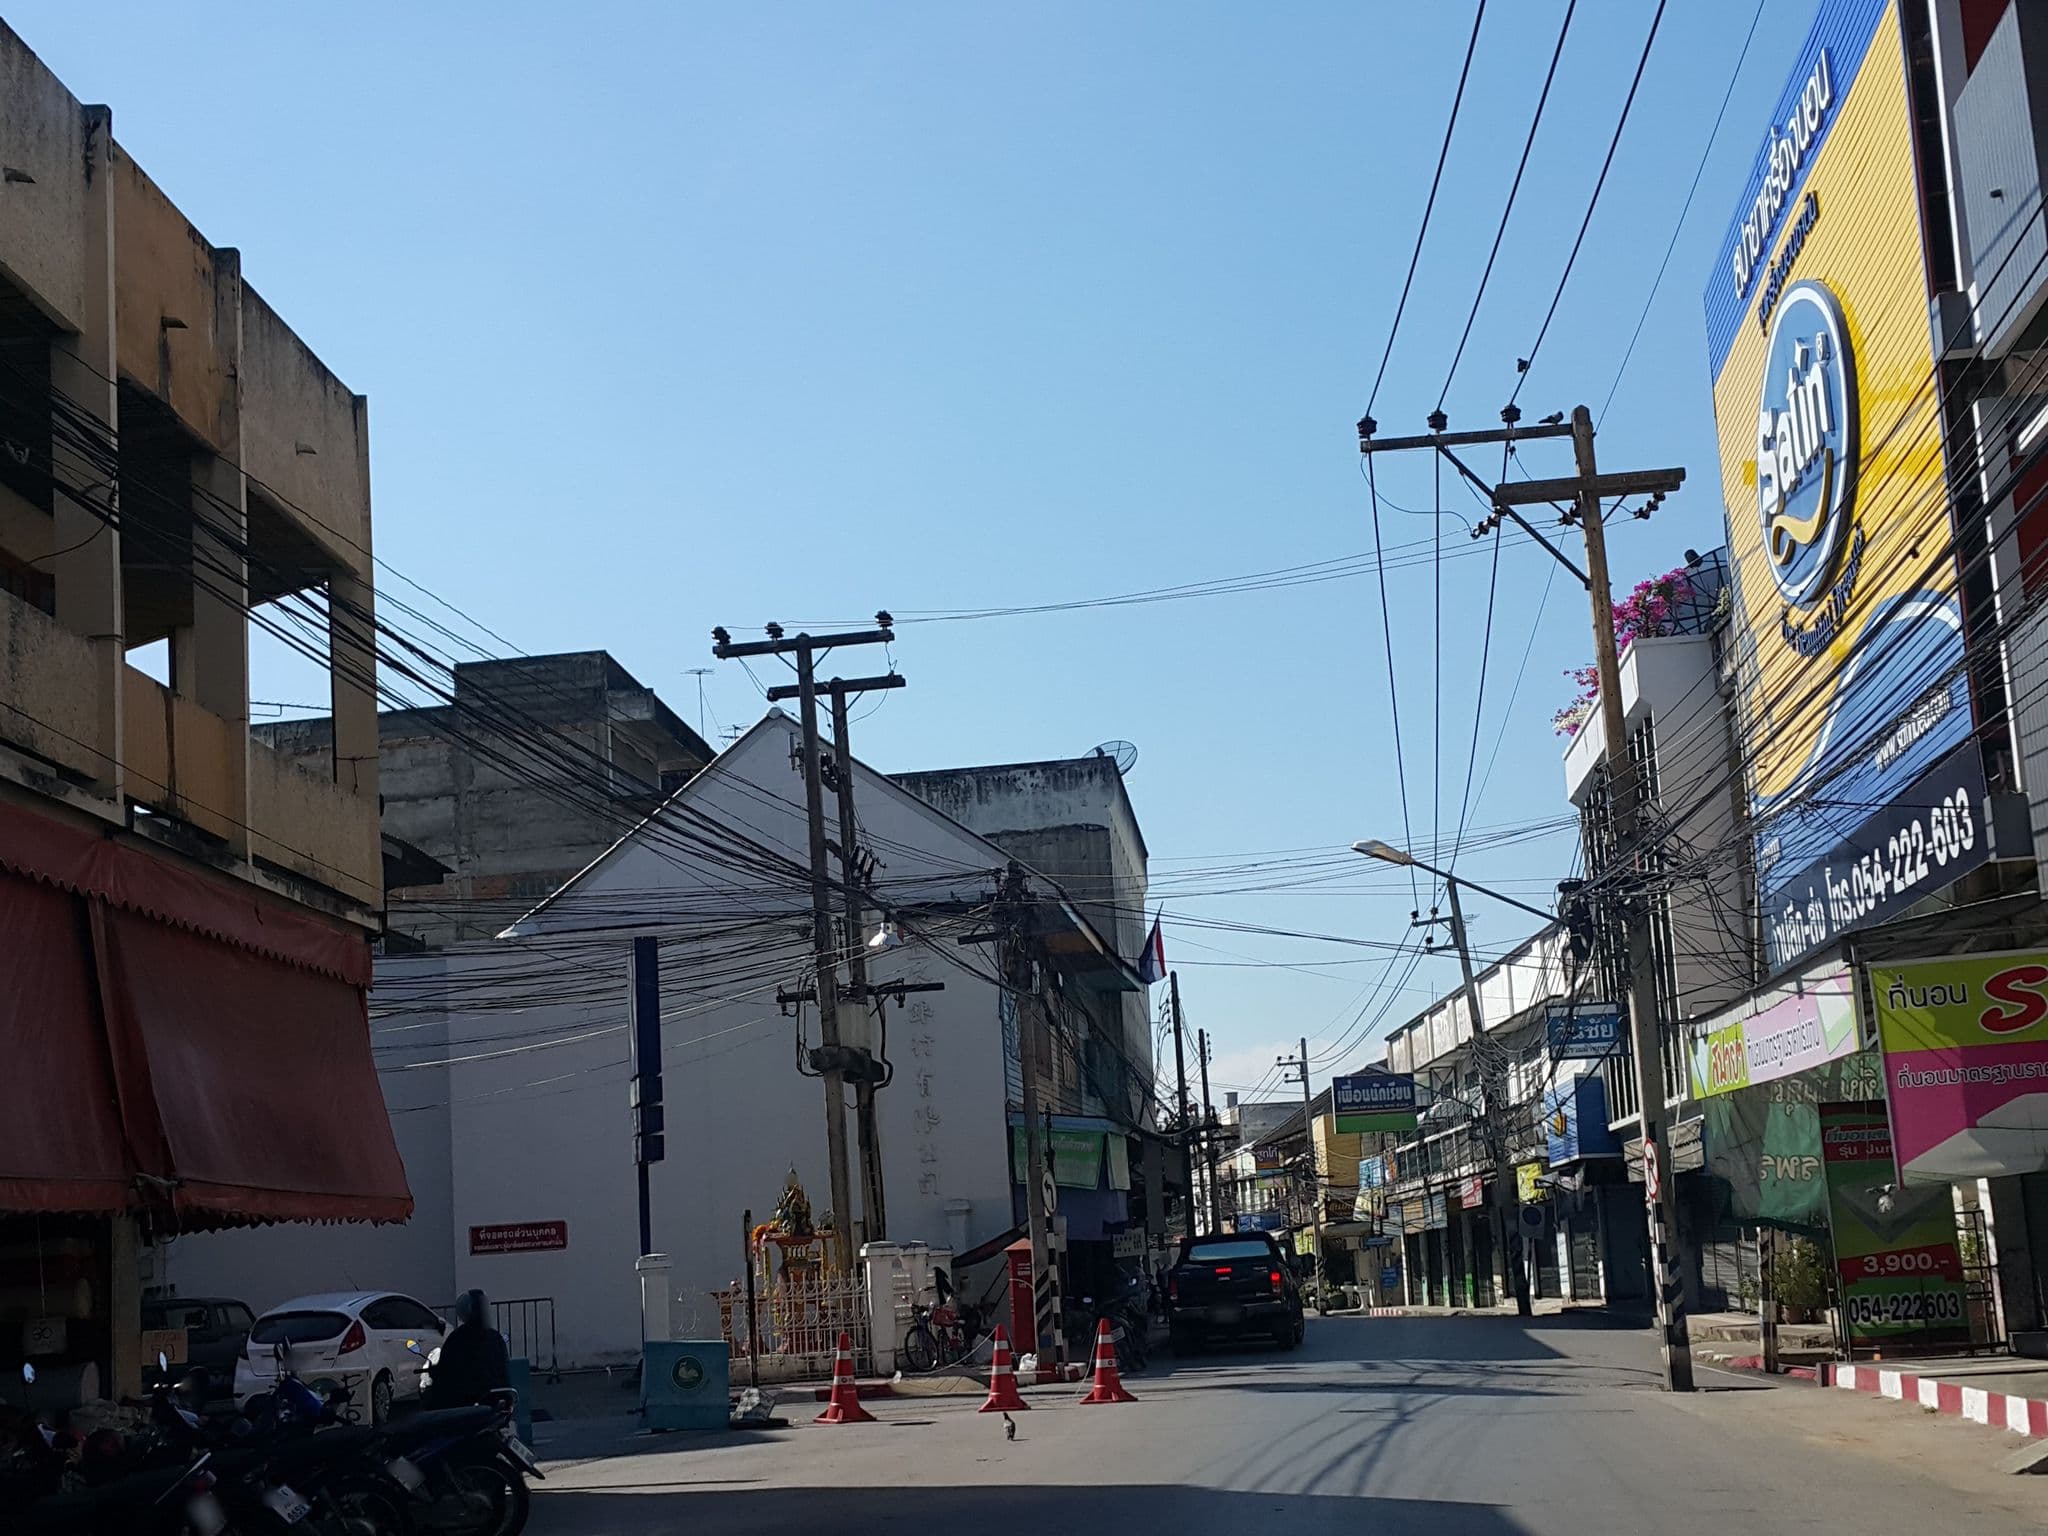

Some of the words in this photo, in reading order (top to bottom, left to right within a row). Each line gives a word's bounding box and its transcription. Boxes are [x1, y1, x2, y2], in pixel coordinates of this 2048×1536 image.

[1758, 336, 1832, 515] Satin
[1888, 974, 1968, 1009] ที่นอน
[479, 1227, 557, 1240] ที่จอดรถส่วนบุคคล
[1863, 1252, 1950, 1276] 3,900.-
[1847, 1291, 1961, 1324] 054-222603
